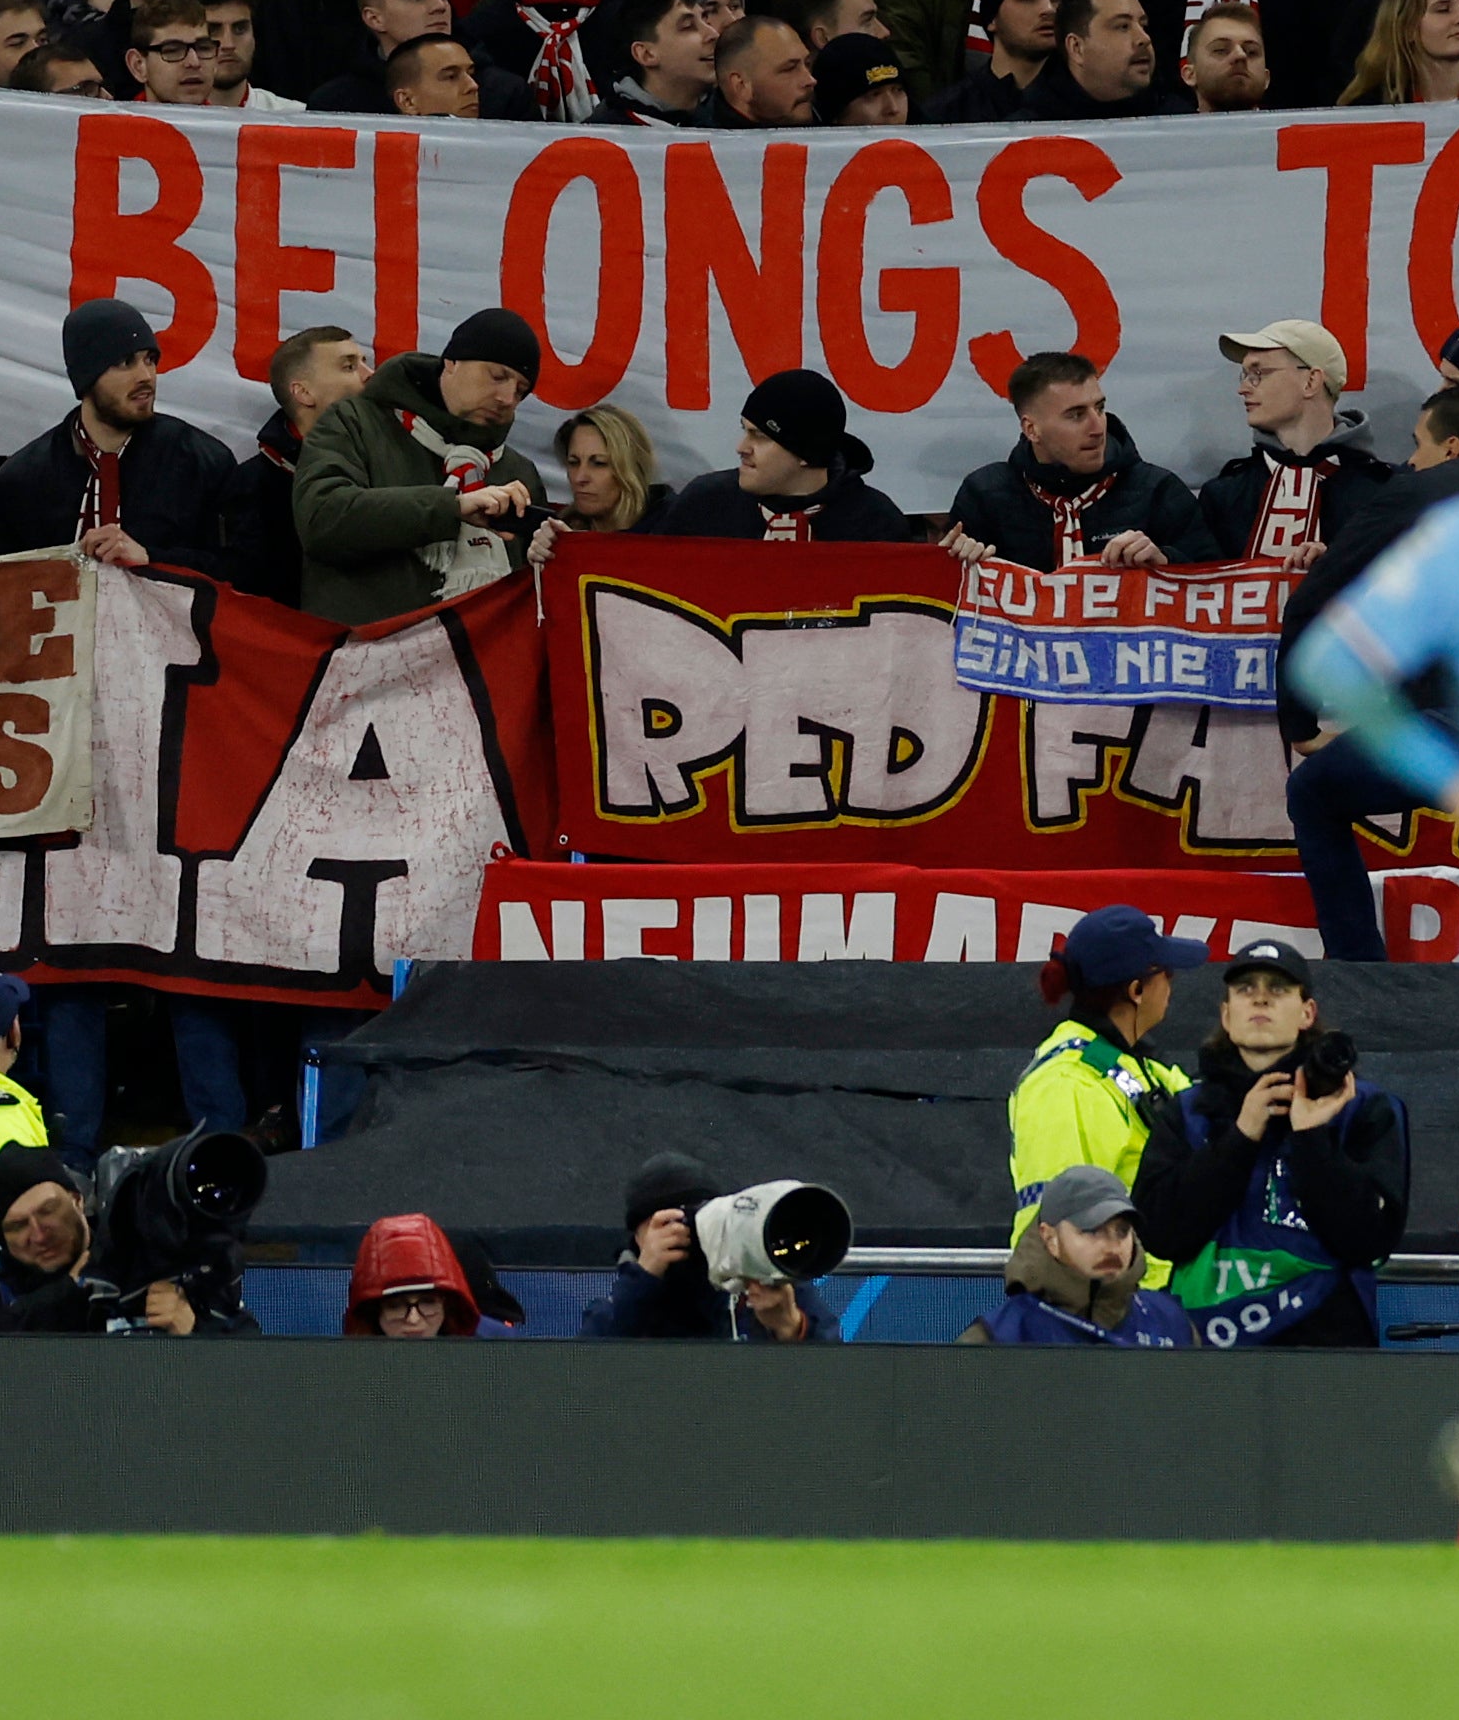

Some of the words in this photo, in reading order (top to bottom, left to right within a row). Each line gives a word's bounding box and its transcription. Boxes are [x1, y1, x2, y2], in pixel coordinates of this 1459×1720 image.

[72, 115, 1119, 413] BELONGS
[587, 582, 990, 826] RED
[1215, 1258, 1272, 1295] TV
